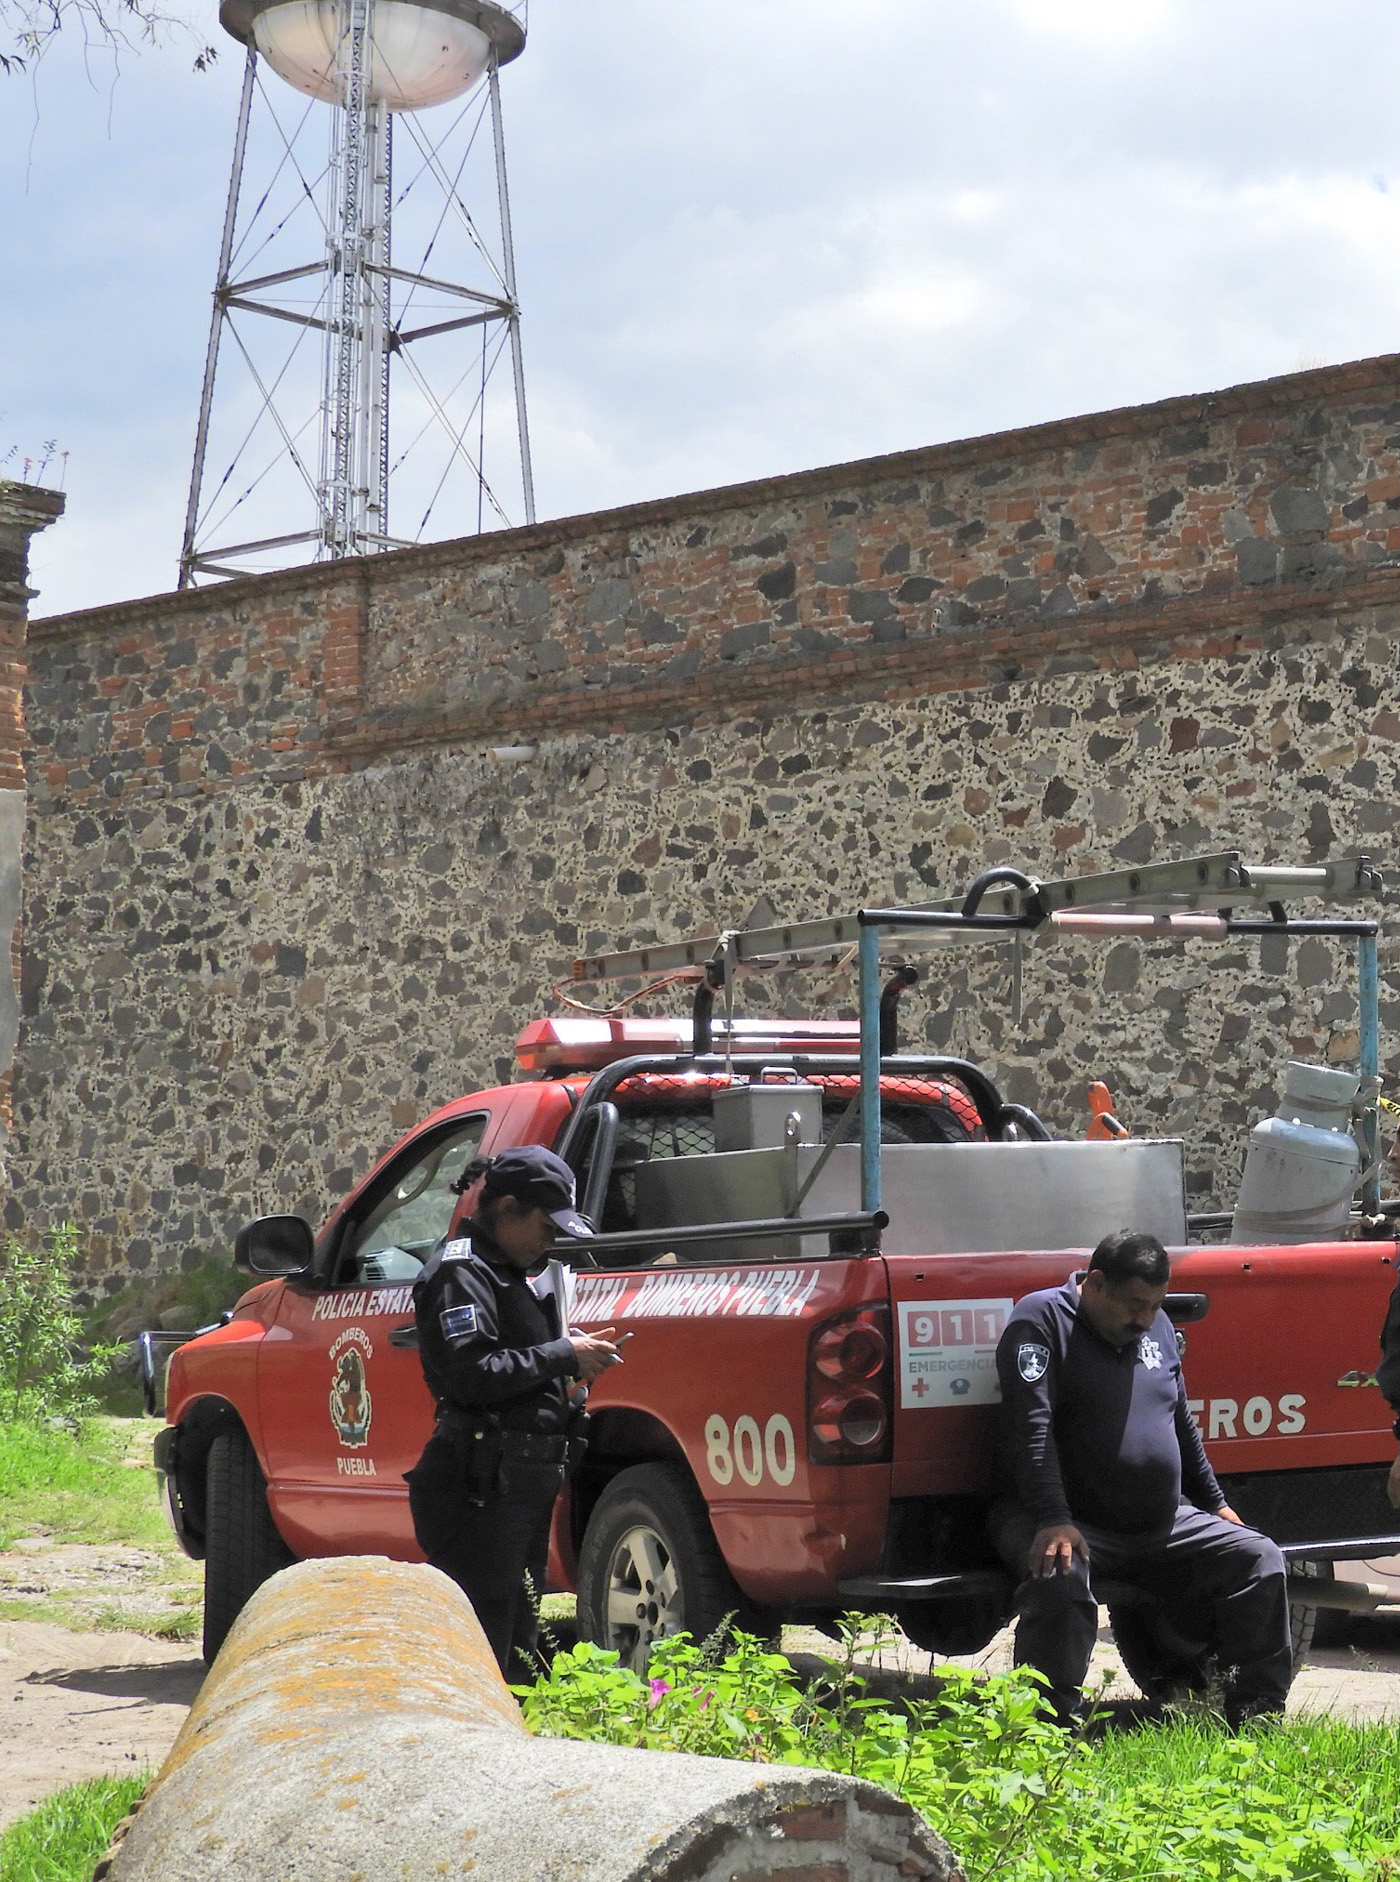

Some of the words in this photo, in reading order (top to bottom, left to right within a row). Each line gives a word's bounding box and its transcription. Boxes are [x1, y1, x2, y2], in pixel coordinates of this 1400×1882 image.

[312, 1291, 367, 1321] POLICIA
[364, 1286, 416, 1317] ESTATA
[570, 1277, 629, 1323] STATAL
[622, 1271, 742, 1319] BOMBEROS
[721, 1269, 820, 1317] PUEBLA
[328, 1327, 374, 1360] BOMBEROS
[914, 1313, 996, 1343] 911
[337, 1457, 377, 1476] PUEBLA
[704, 1413, 796, 1487] 800
